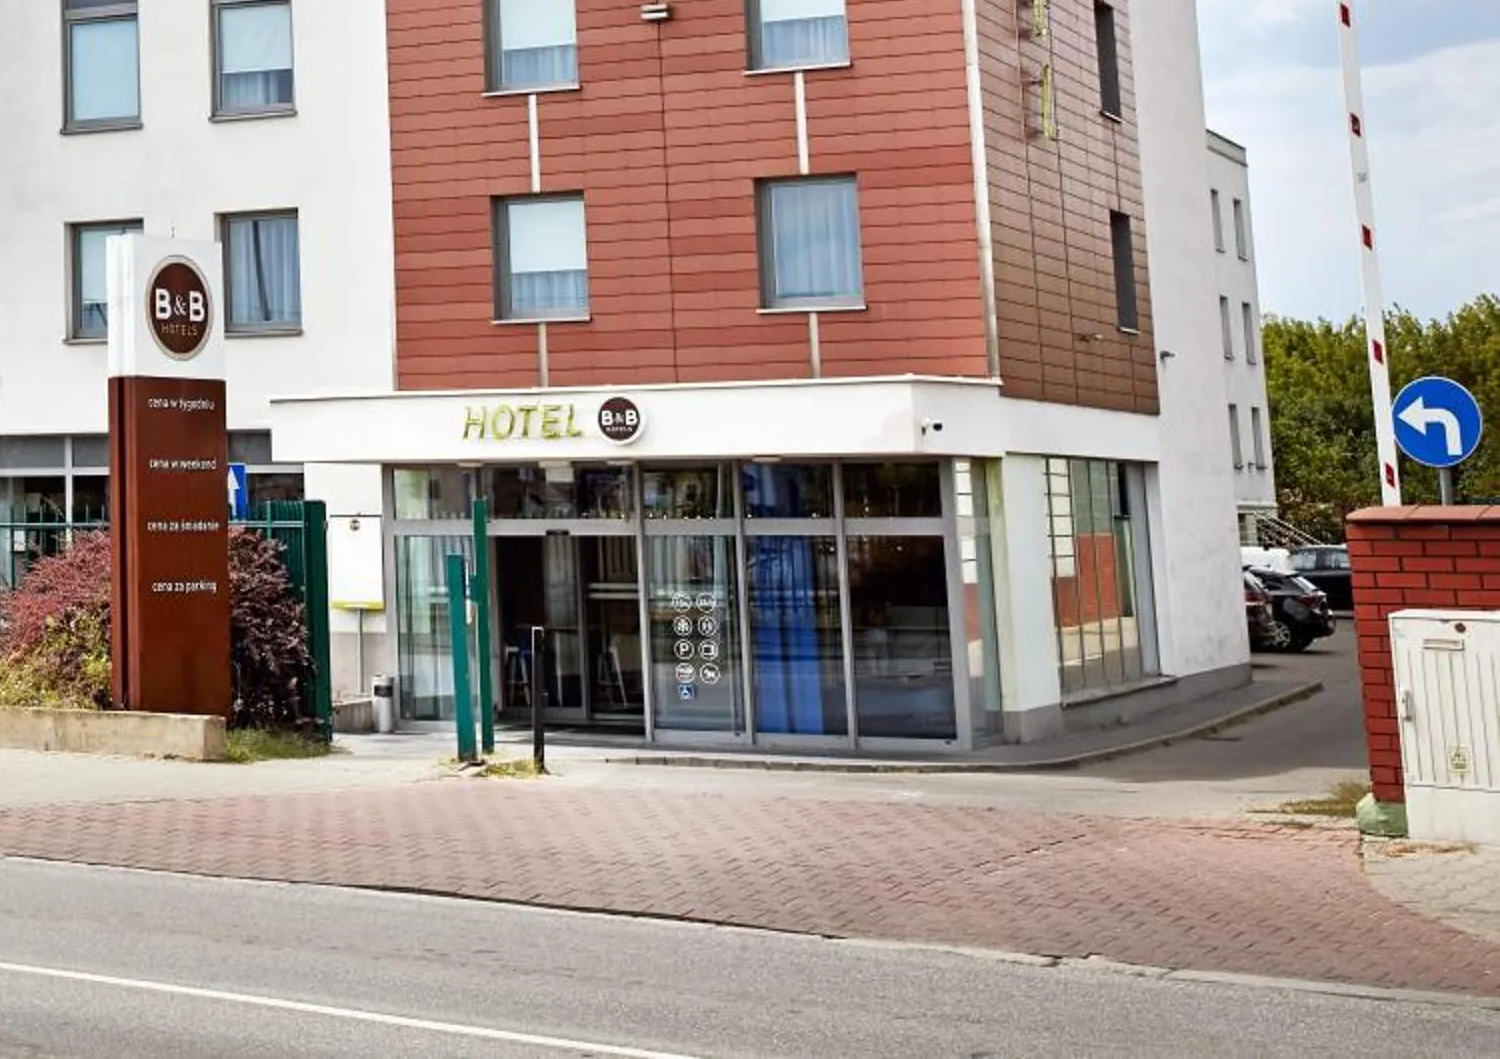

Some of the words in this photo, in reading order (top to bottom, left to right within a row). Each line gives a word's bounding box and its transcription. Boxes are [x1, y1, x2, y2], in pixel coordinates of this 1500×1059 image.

[155, 287, 206, 323] B&B
[161, 323, 198, 337] HOTELS
[148, 398, 169, 409] cena
[462, 403, 584, 441] HOTEL
[601, 410, 639, 427] B&B
[149, 459, 169, 470] cena
[147, 522, 168, 532] cena
[152, 582, 173, 592] cena
[185, 580, 217, 594] parking
